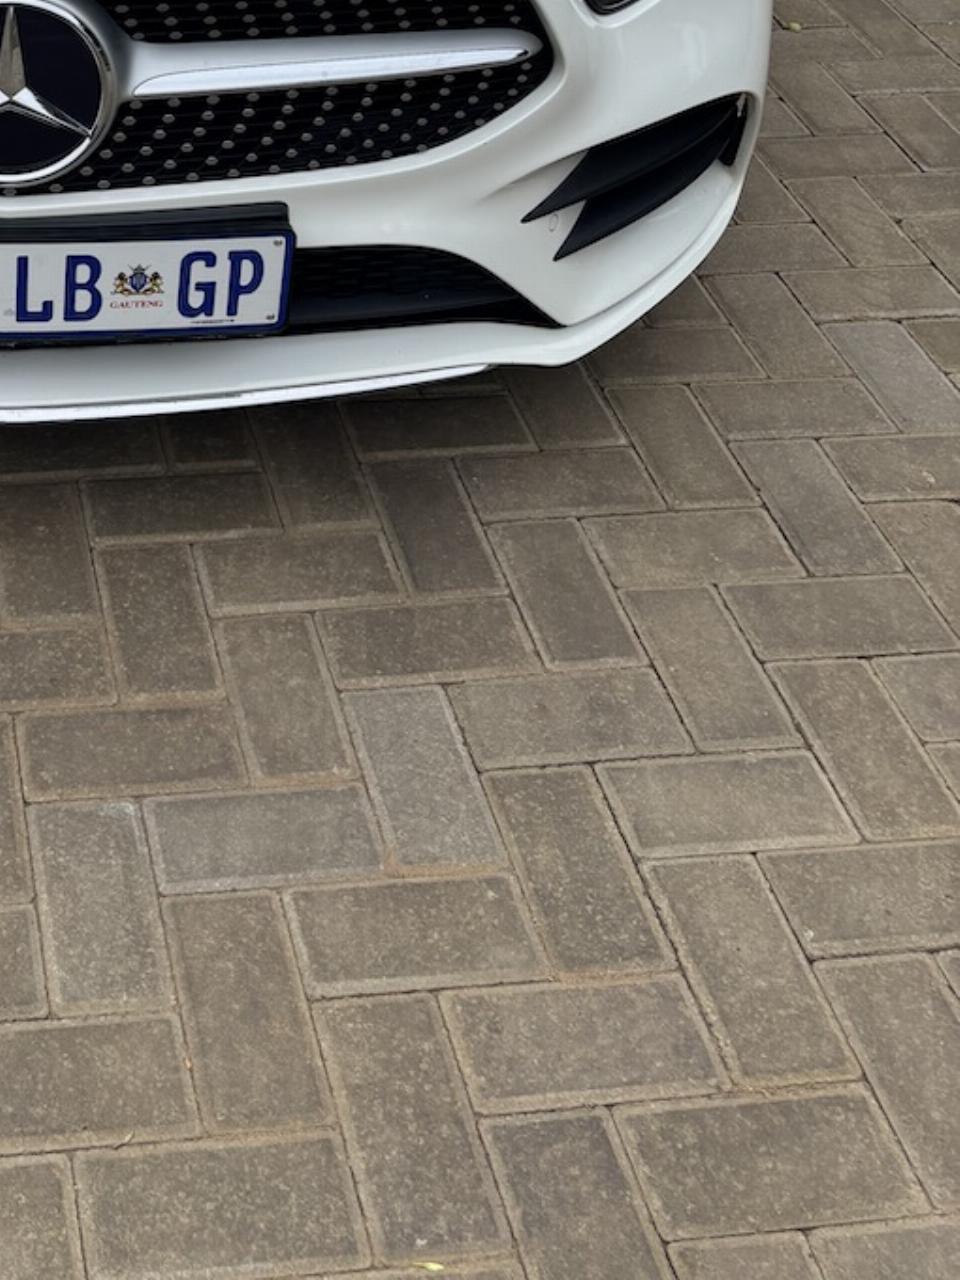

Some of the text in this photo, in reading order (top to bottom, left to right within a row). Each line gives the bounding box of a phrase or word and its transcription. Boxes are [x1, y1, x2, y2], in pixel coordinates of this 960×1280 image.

[15, 255, 103, 322] LB
[177, 249, 264, 318] GP
[109, 300, 164, 309] GAUTENG
